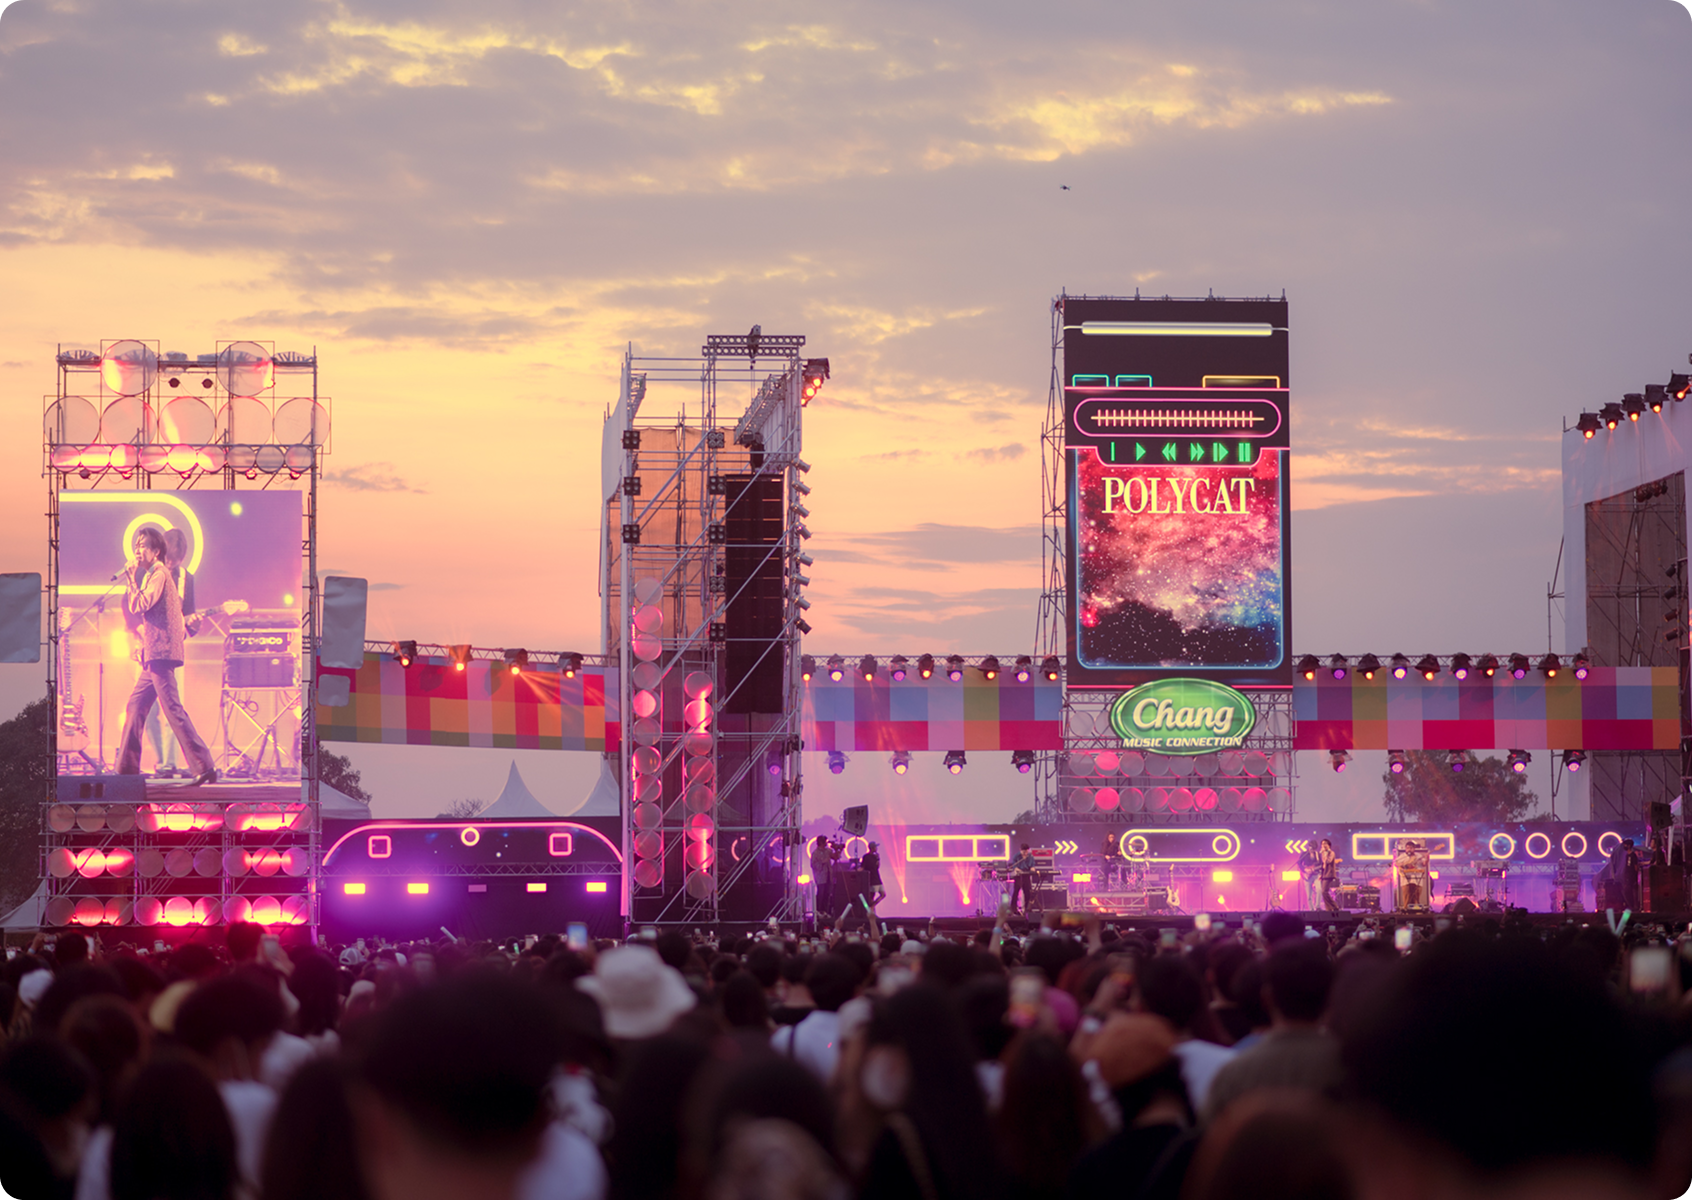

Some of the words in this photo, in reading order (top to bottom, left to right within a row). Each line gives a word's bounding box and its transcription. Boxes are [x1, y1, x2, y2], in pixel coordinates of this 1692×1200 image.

[1101, 477, 1255, 515] POLYCAT
[1133, 697, 1235, 735] Chang
[1122, 737, 1163, 748] MUSIC
[1165, 737, 1243, 748] CONNECTION
